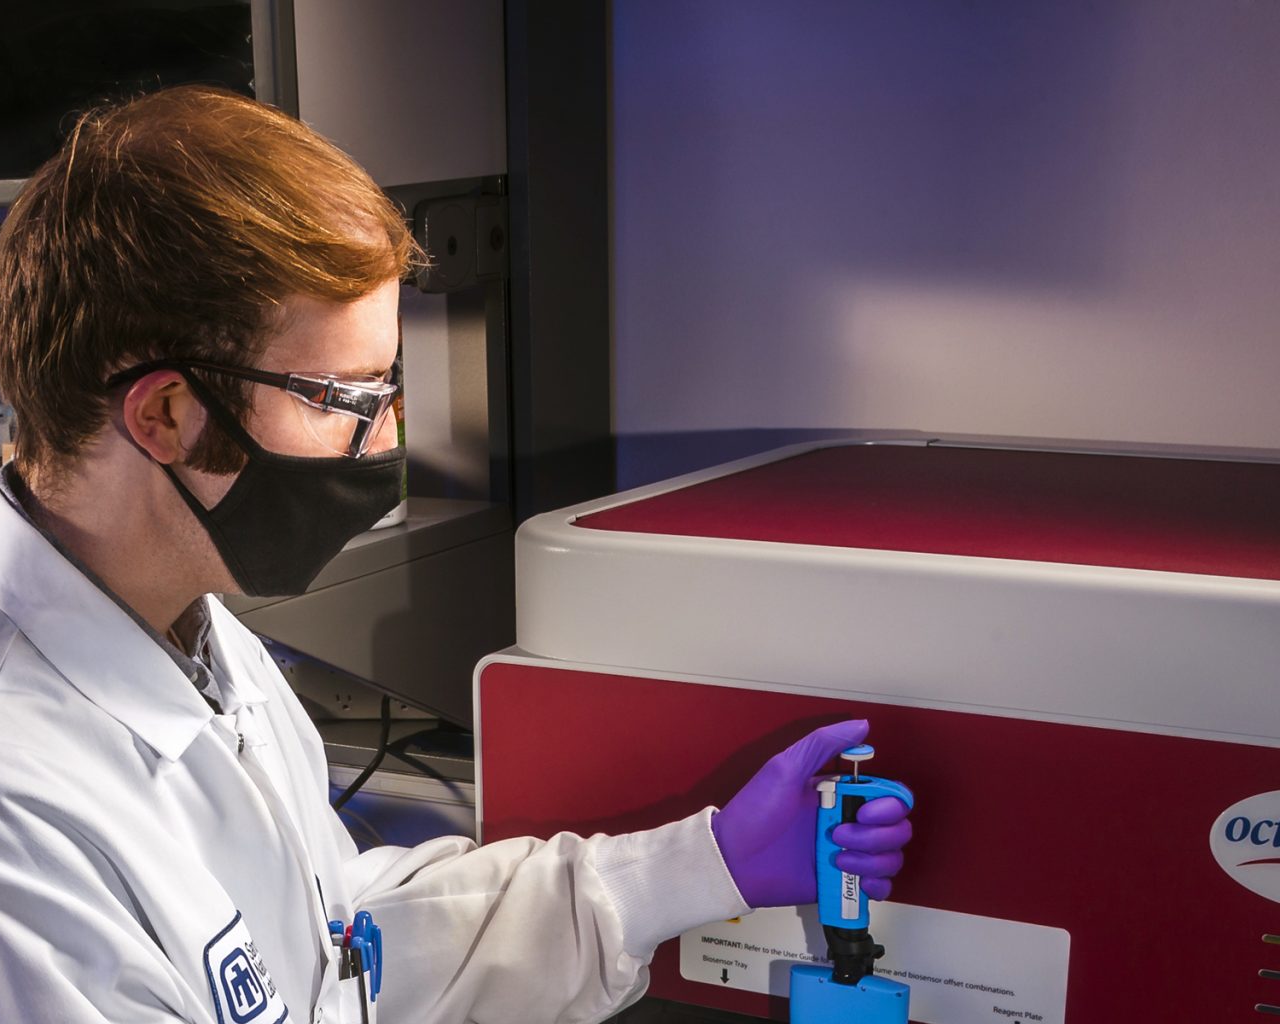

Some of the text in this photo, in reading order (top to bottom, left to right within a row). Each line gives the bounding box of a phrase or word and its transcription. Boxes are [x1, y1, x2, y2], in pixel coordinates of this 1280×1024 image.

[701, 936, 743, 949] IMPORTANT:
[744, 943, 761, 952] Refer
[771, 948, 782, 956] the
[783, 950, 798, 959] User
[799, 952, 818, 962] Guide
[702, 955, 748, 970] Biosensor Tray
[893, 970, 907, 978] and
[908, 971, 942, 984] biosensor
[943, 978, 964, 988] offset
[965, 982, 1015, 997] combinations.
[993, 1006, 1043, 1021] Reagent Plate
